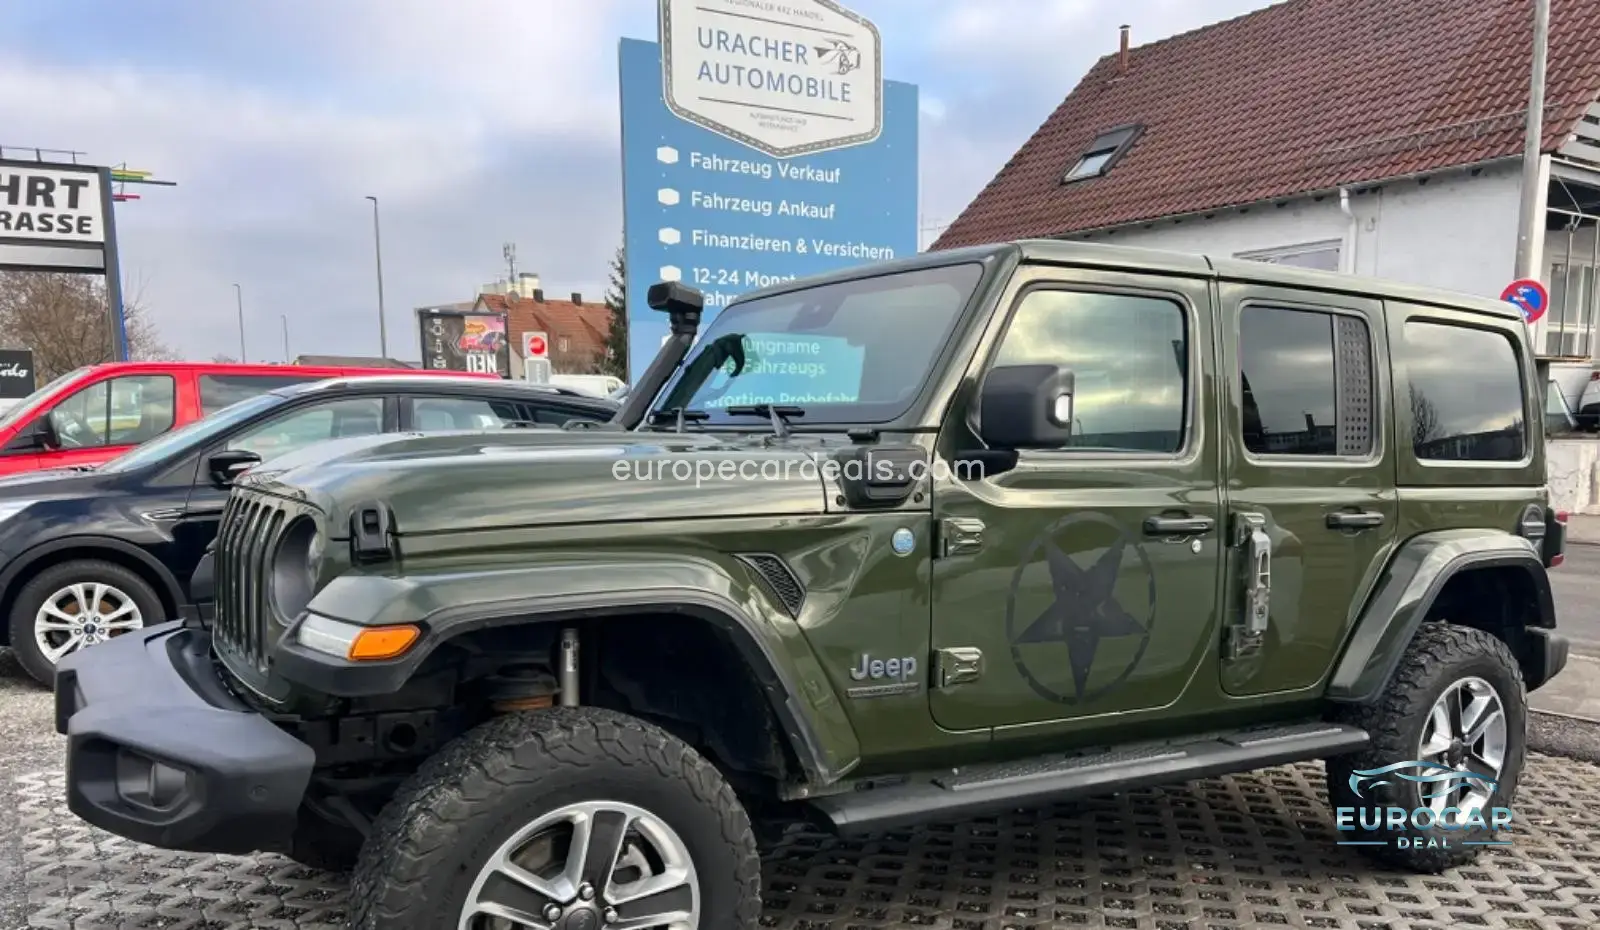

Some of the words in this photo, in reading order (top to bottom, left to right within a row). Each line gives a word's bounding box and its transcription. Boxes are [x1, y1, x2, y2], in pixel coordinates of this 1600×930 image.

[697, 26, 808, 65] URACHER
[697, 60, 851, 103] AUTOMOBILE
[691, 152, 772, 178] Fahrzeug
[777, 162, 841, 184] Verkauf
[691, 191, 772, 215] Fahrzeug
[777, 202, 836, 219] Ankauf
[692, 229, 792, 253] Finanzieren
[795, 238, 807, 254] &
[812, 239, 895, 260] Versichern
[692, 267, 740, 286] 12-24
[850, 653, 917, 682] Jeep
